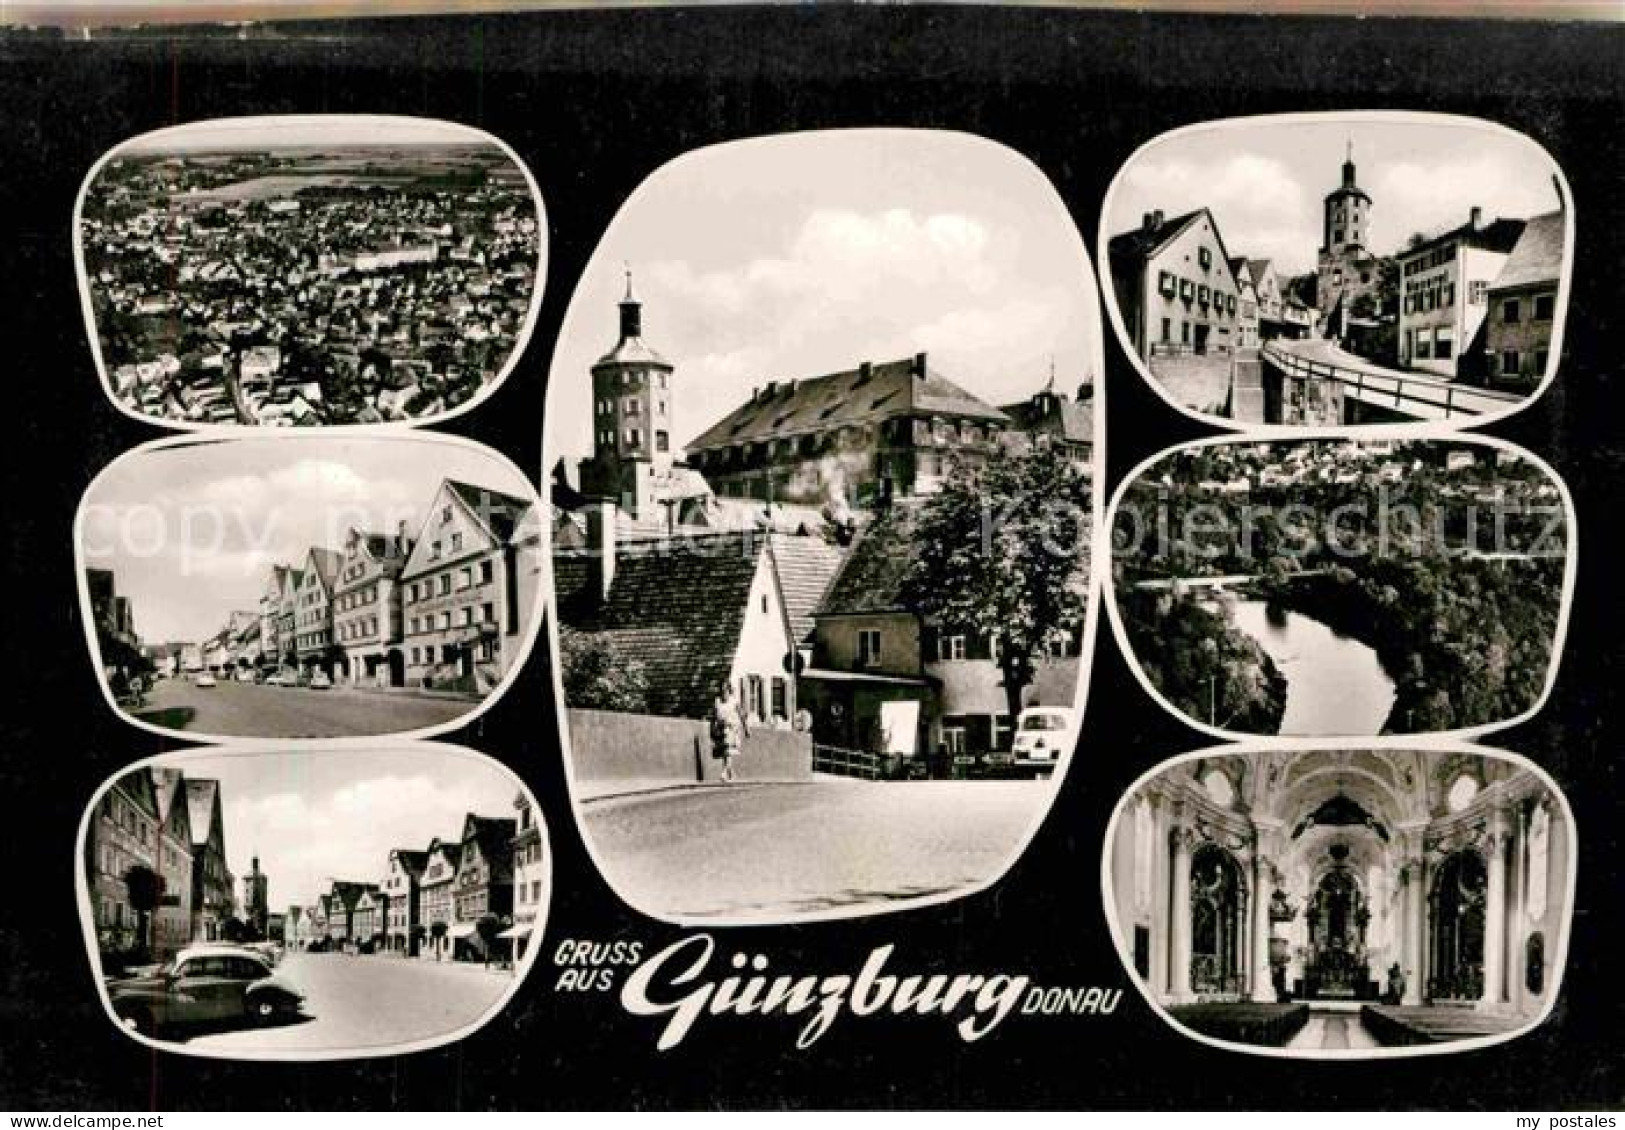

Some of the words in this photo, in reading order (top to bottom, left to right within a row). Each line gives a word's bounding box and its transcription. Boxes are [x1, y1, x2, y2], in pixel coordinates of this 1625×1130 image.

[554, 938, 643, 966] GRUSS
[554, 968, 614, 992] AUS
[620, 932, 1029, 1051] Günzburg
[1021, 986, 1123, 1015] DONAU
